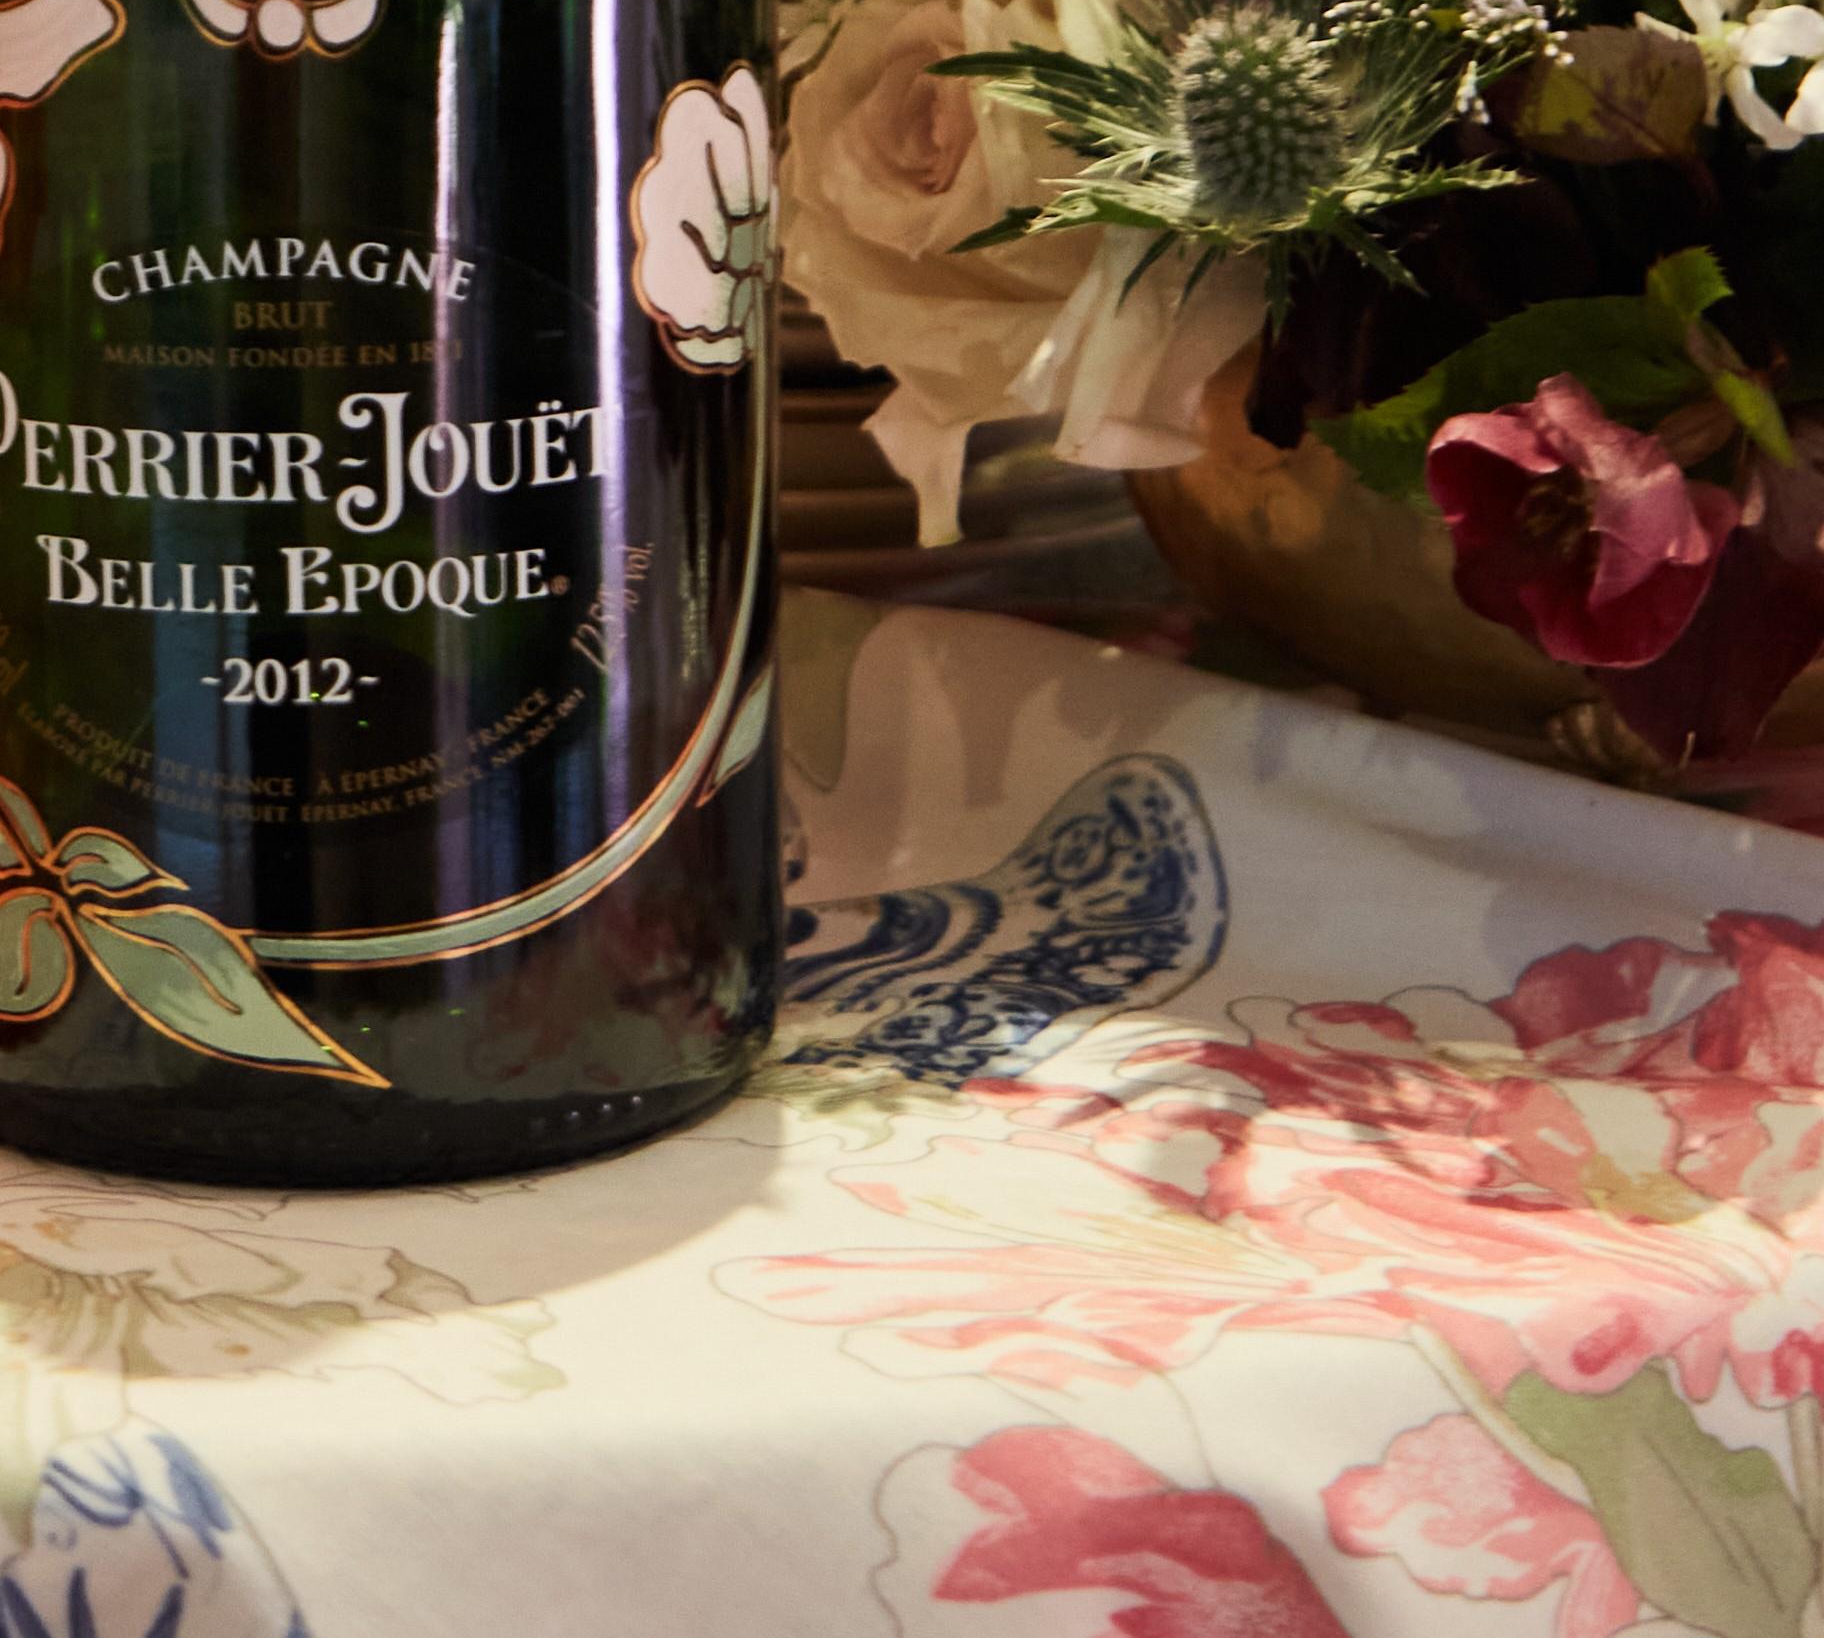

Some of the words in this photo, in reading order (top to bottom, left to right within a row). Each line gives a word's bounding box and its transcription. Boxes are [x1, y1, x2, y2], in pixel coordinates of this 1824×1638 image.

[91, 236, 476, 306] CHAMPAGNE
[232, 300, 334, 331] BRUT
[102, 342, 217, 368] MAISON
[226, 336, 347, 368] FONDÉE
[358, 341, 397, 365] EN
[34, 533, 260, 617] BELLE
